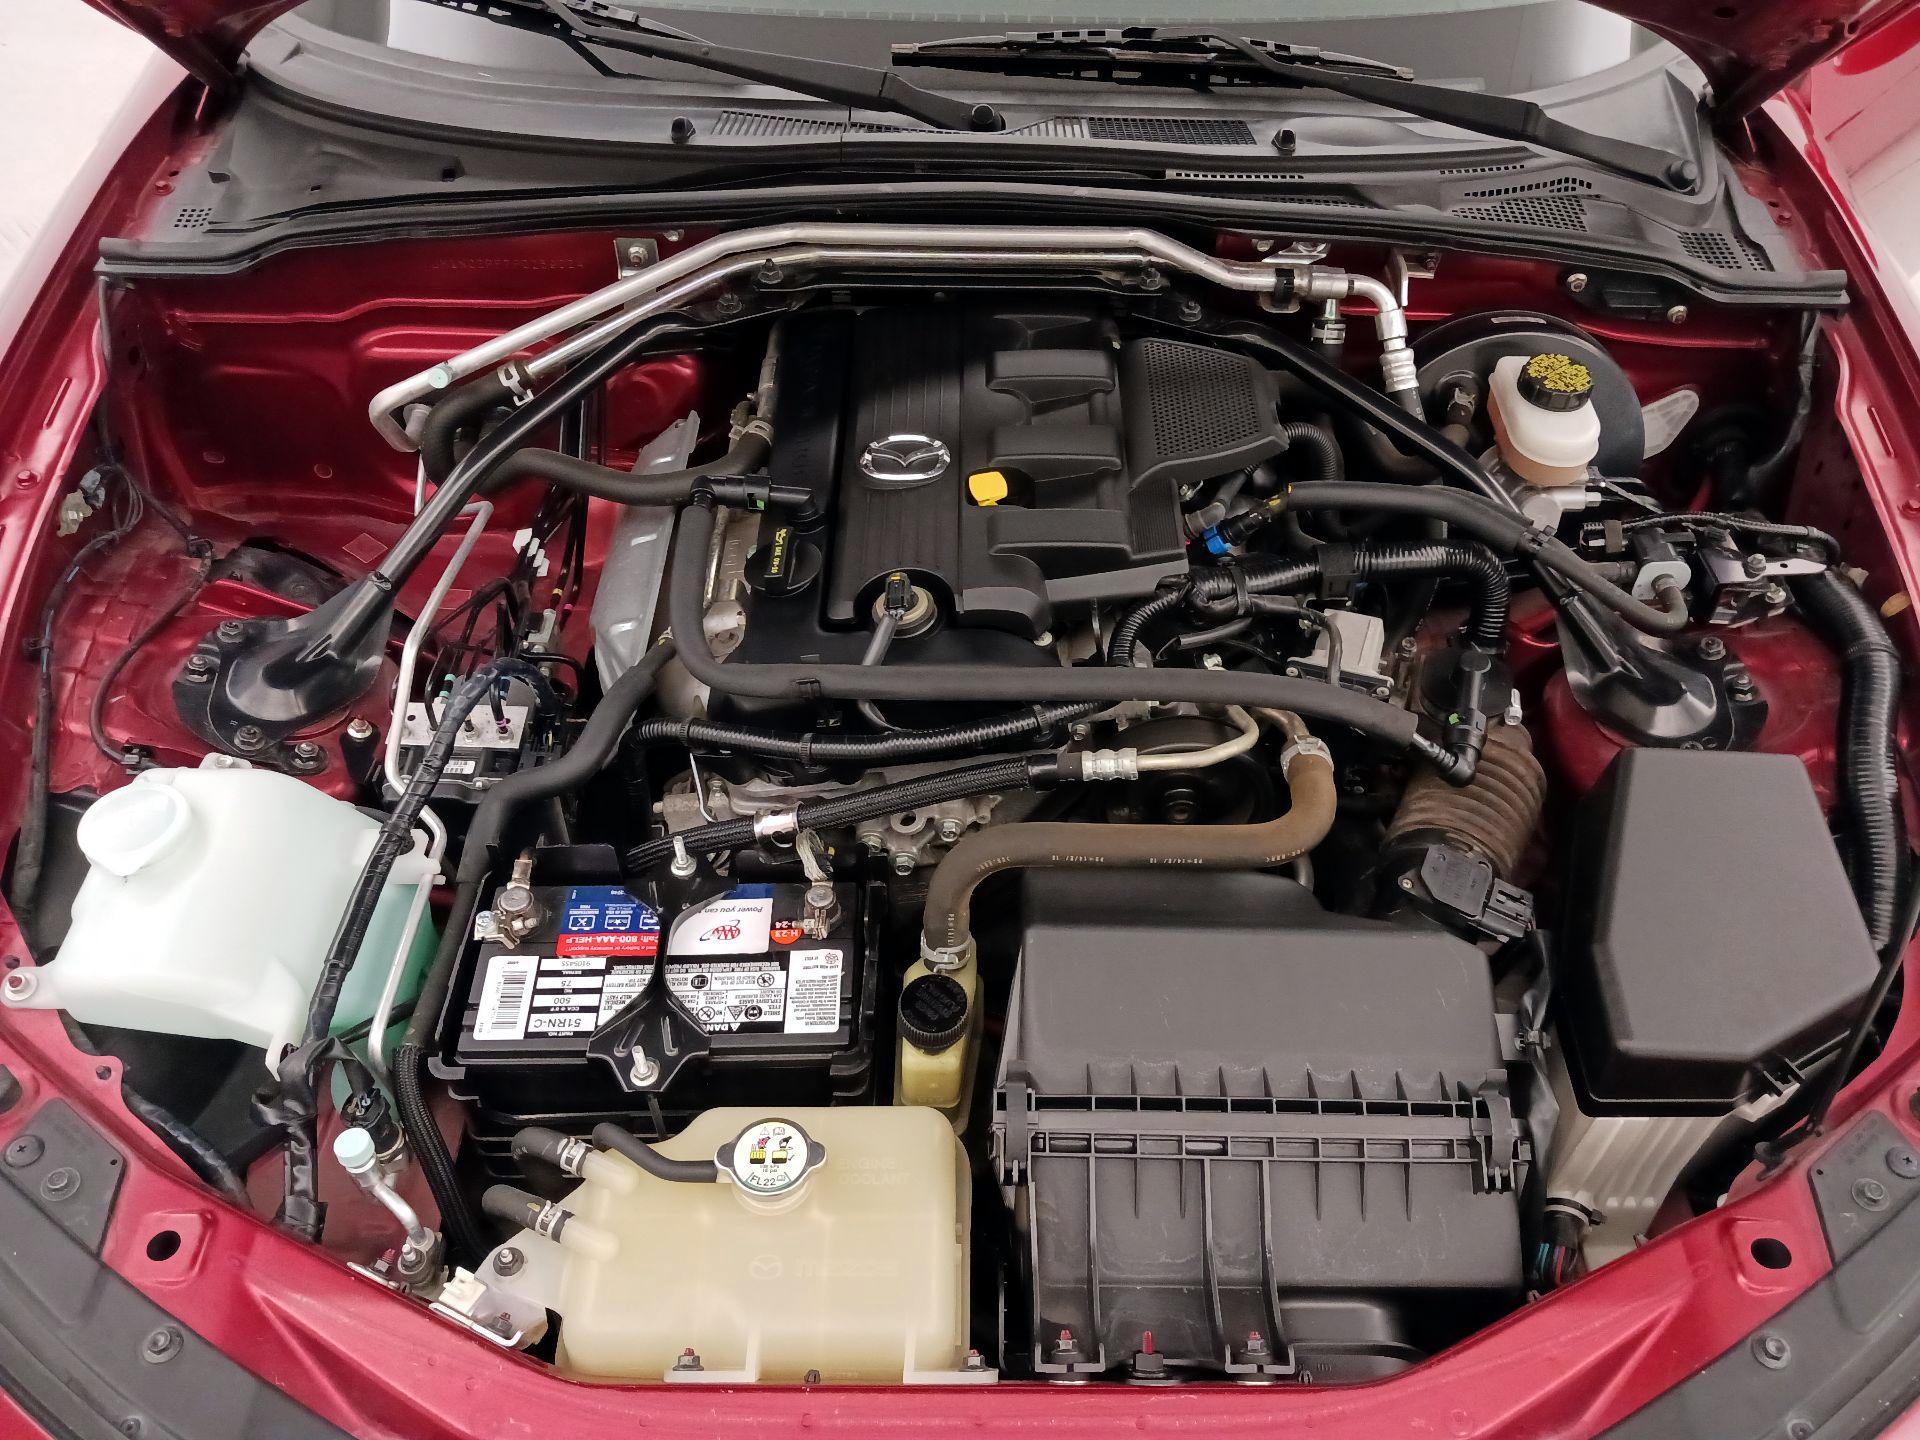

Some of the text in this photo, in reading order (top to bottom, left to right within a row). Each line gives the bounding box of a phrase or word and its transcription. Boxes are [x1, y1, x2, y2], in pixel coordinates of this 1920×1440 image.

[720, 905, 736, 913] you
[712, 925, 740, 940] AAA
[774, 929, 798, 937] H-23
[565, 935, 638, 944] 800-AAA-HELP
[533, 1018, 581, 1029] 51RN-C
[749, 1175, 777, 1187] FL22
